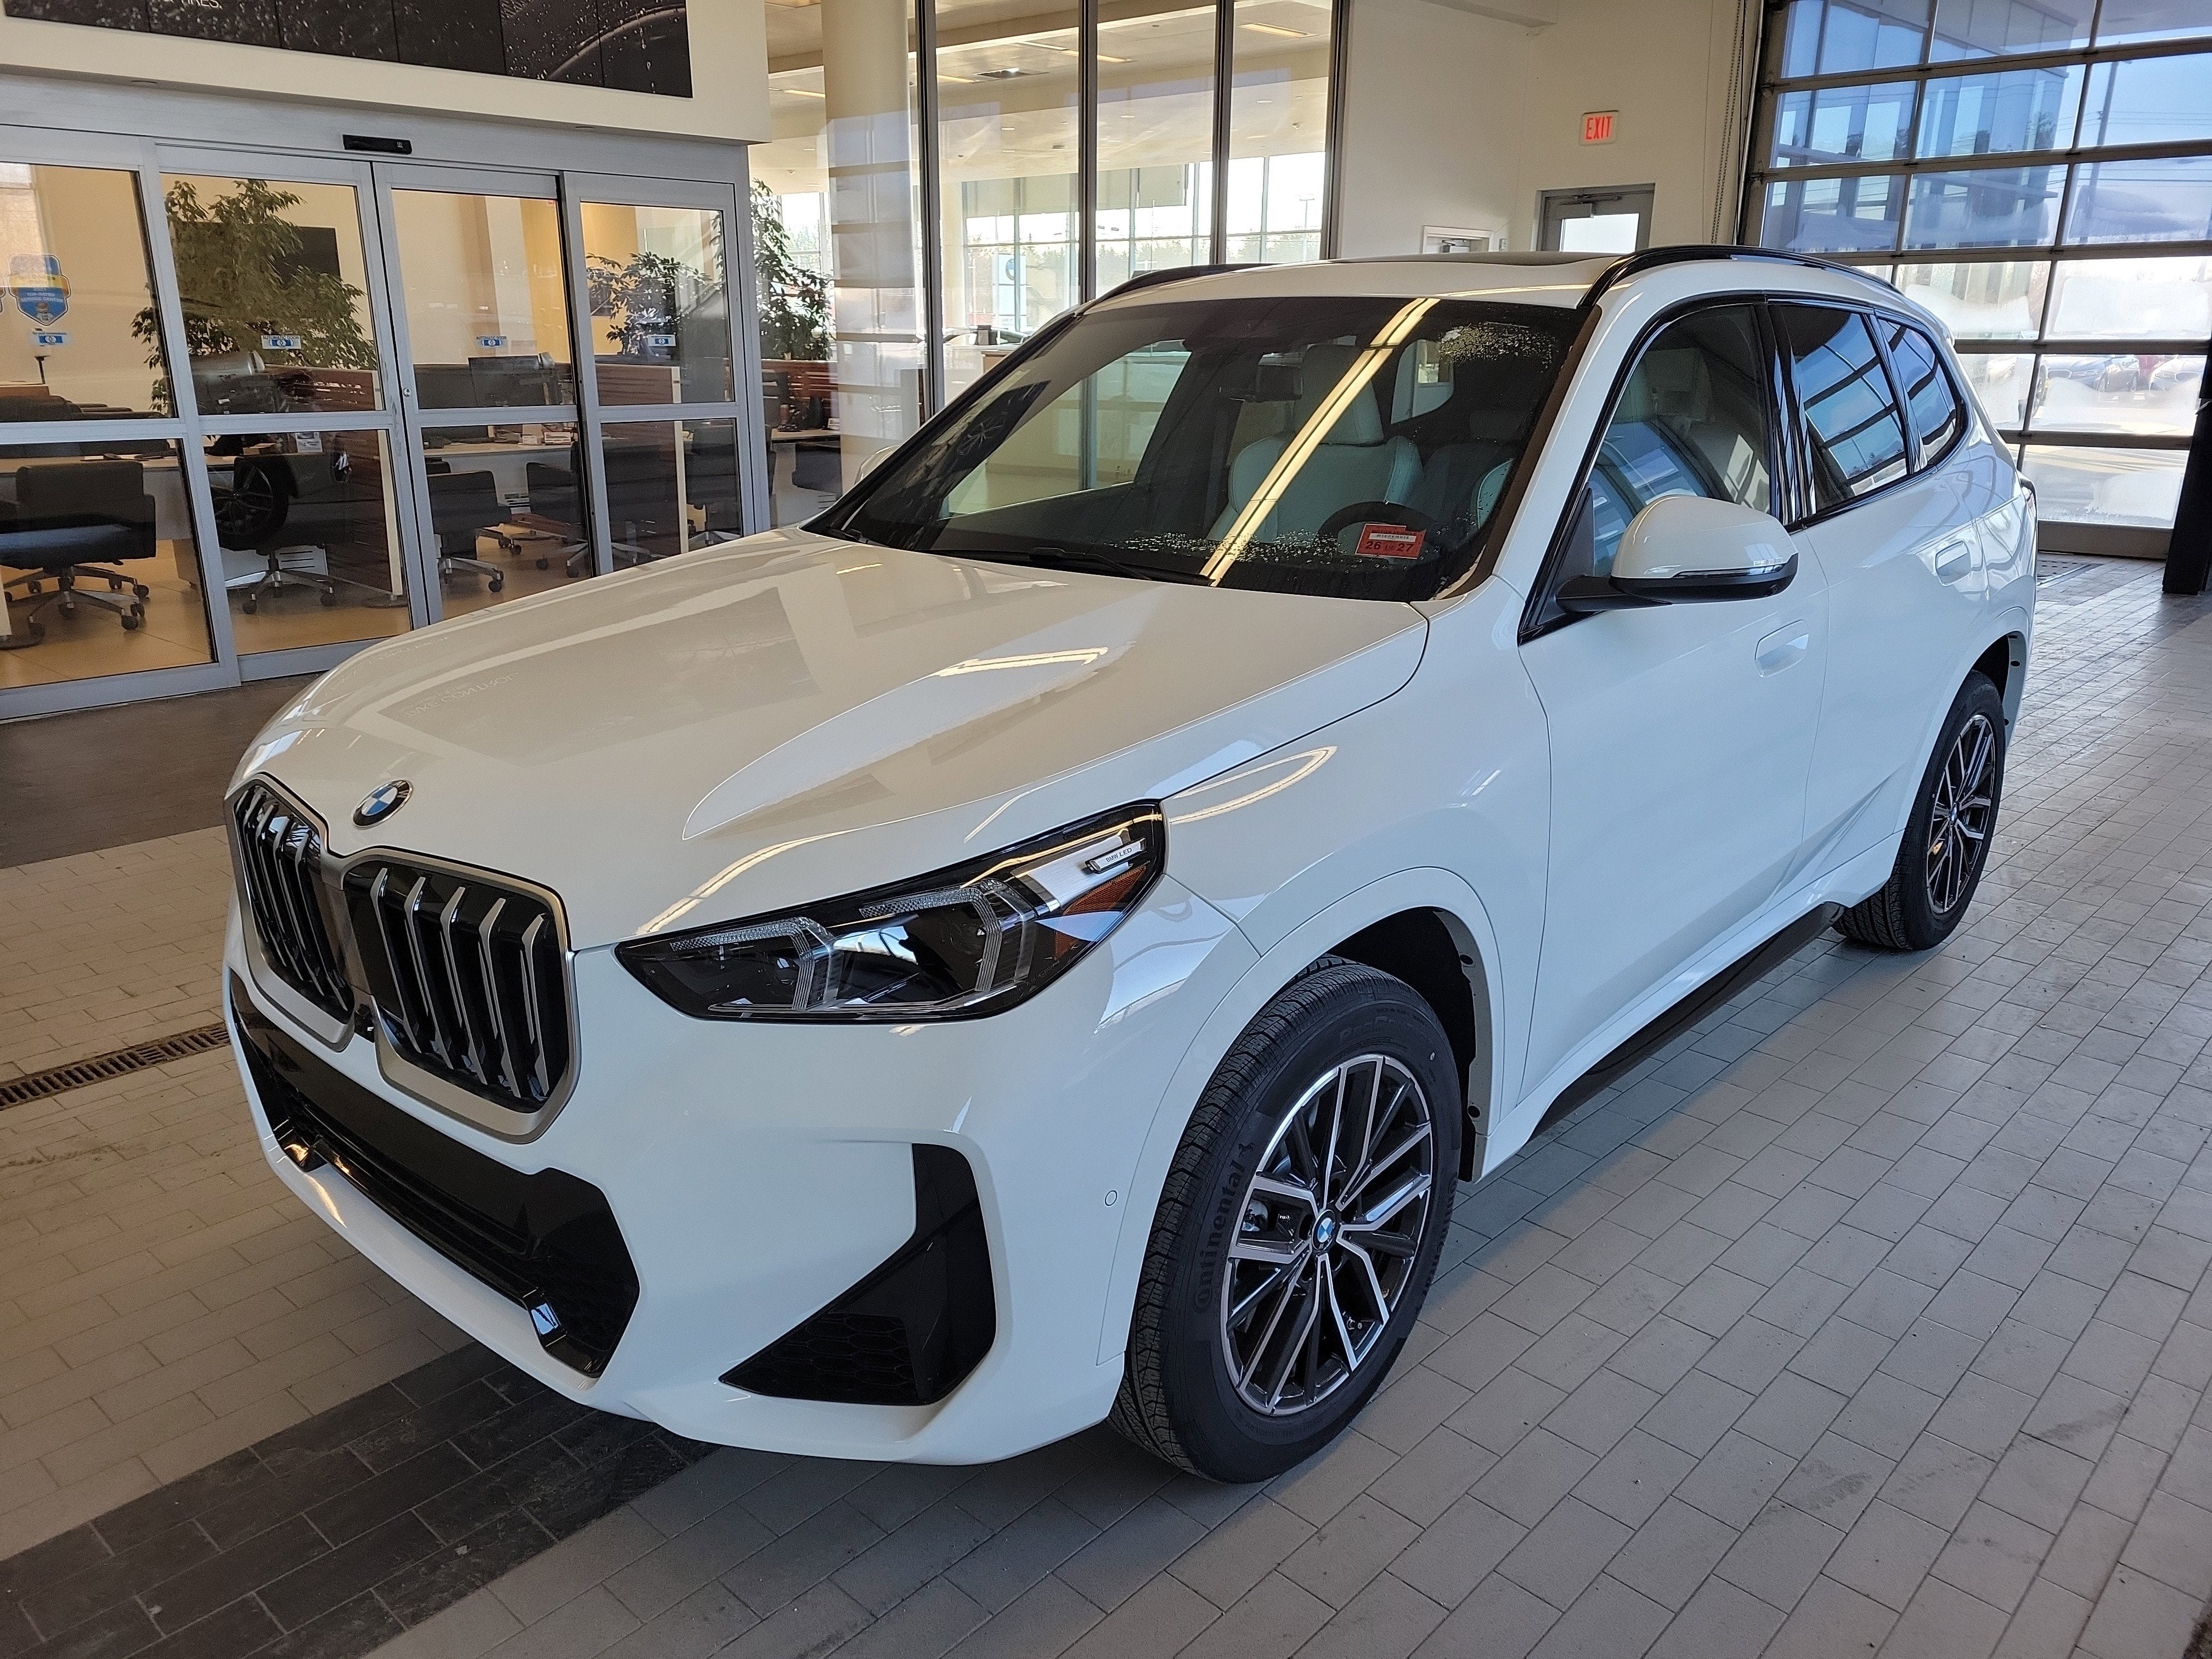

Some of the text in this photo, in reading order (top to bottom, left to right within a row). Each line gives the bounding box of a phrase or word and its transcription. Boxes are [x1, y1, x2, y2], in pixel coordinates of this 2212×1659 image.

[1585, 116, 1612, 139] EXIT
[1365, 541, 1382, 550] 26
[1396, 543, 1415, 552] 27
[1105, 848, 1132, 862] BMW LED
